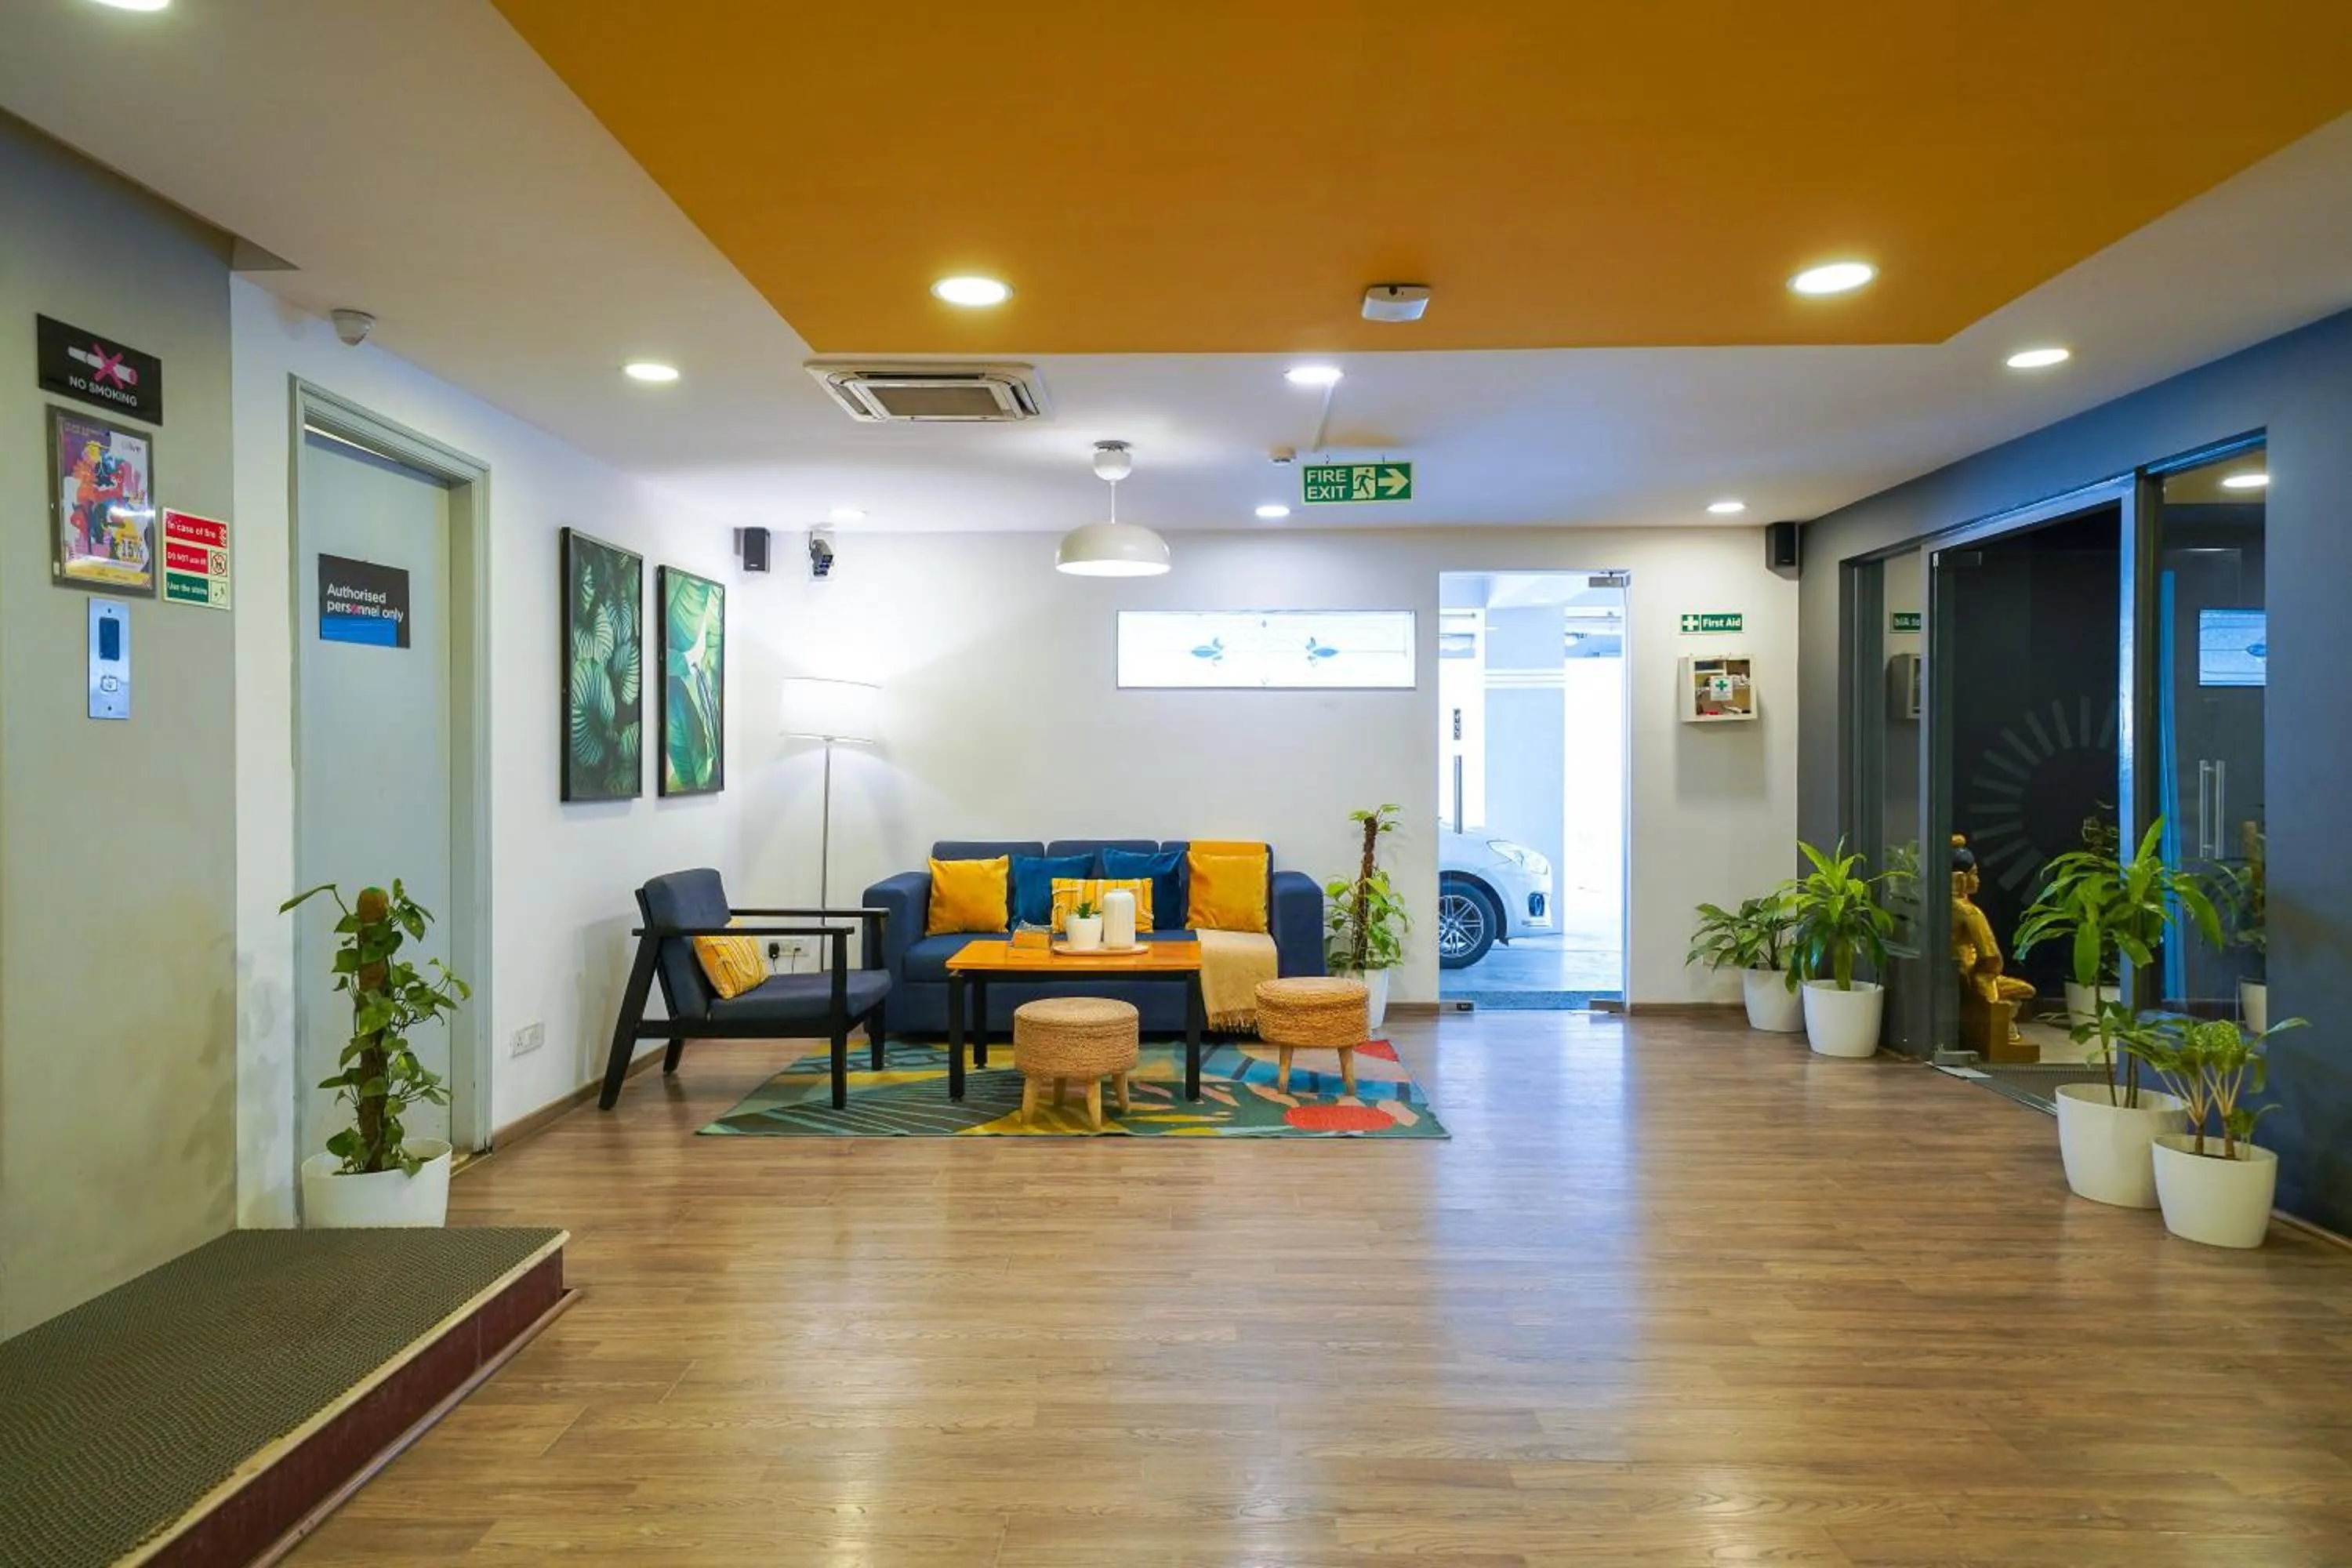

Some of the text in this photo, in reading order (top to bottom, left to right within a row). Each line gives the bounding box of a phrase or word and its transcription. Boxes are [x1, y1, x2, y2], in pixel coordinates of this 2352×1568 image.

[69, 376, 138, 407] NO SMOKING
[1307, 469, 1347, 483] FIRE
[1307, 485, 1347, 499] EXIT
[176, 524, 194, 534] case
[195, 526, 203, 535] of
[327, 583, 387, 604] Authorised
[327, 600, 404, 623] personnel only
[1702, 616, 1741, 628] First Aid
